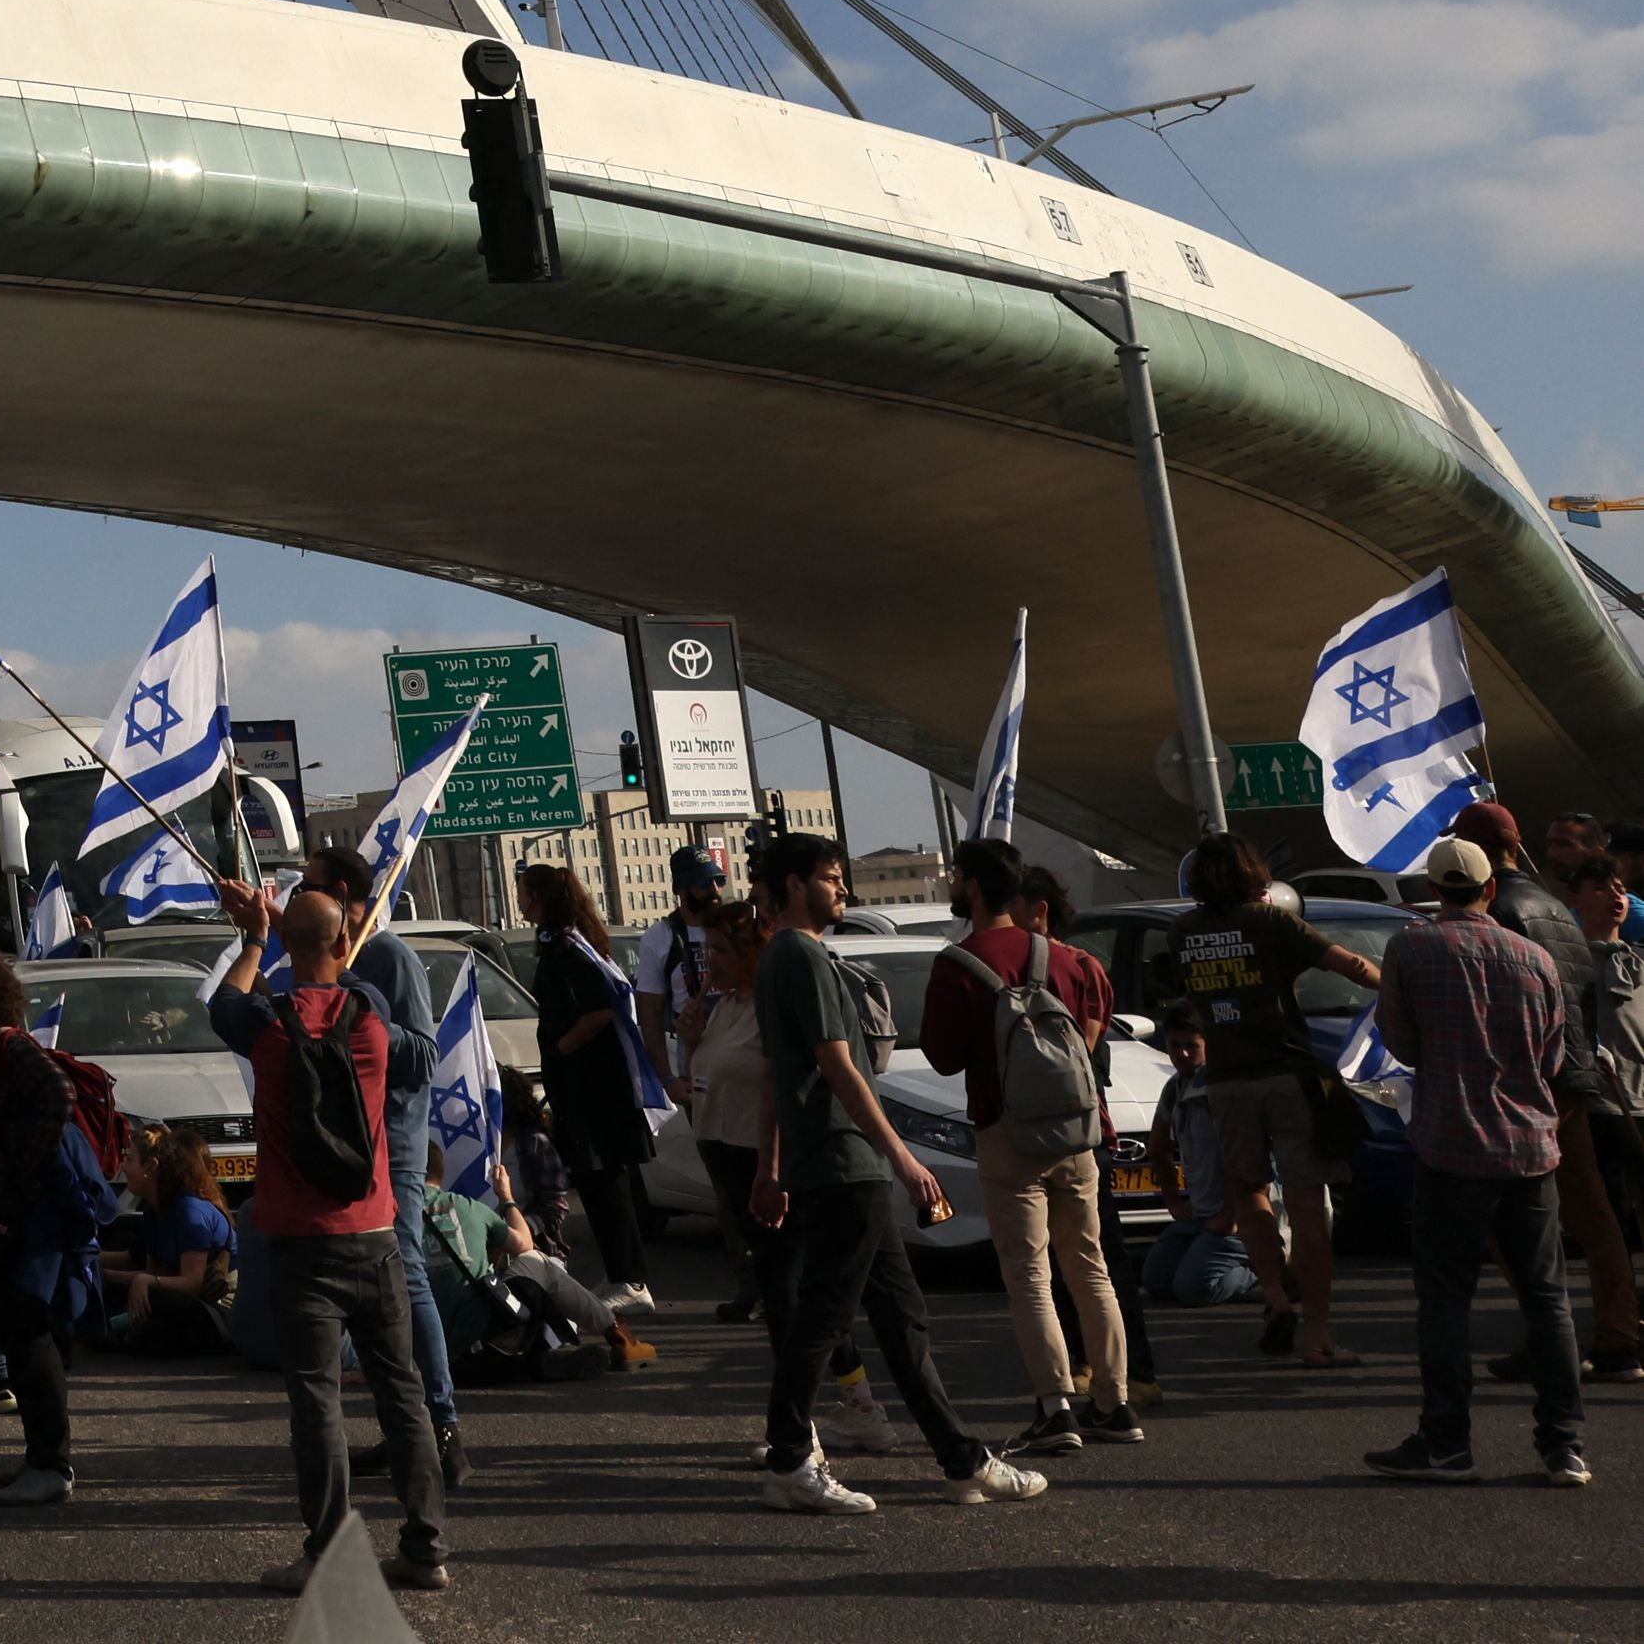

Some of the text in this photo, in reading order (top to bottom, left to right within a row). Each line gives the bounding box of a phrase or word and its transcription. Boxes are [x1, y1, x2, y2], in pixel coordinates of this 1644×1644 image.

[435, 656, 511, 672] מרכז העיר
[443, 676, 508, 690] مركز المدينة
[455, 692, 502, 705] Cener
[498, 714, 532, 728] העיר
[493, 734, 520, 746] البلدة
[670, 737, 735, 756] יחזקאל ובניו
[254, 761, 289, 769] HYUNDAI
[457, 751, 518, 765] Old City
[693, 762, 716, 771] מורשית
[717, 762, 738, 770] סוכנות
[446, 775, 546, 793] הדסה עין כרם
[672, 788, 748, 797] אולם תצוגה מרכז שירות
[458, 795, 540, 812] هداسا عين كيرم
[433, 809, 575, 829] Hadassah En Kerem
[1185, 930, 1243, 950] ההפיכה
[1179, 943, 1255, 964] המשפטית
[1192, 957, 1246, 977] קורעת
[1183, 969, 1265, 993] את העם!
